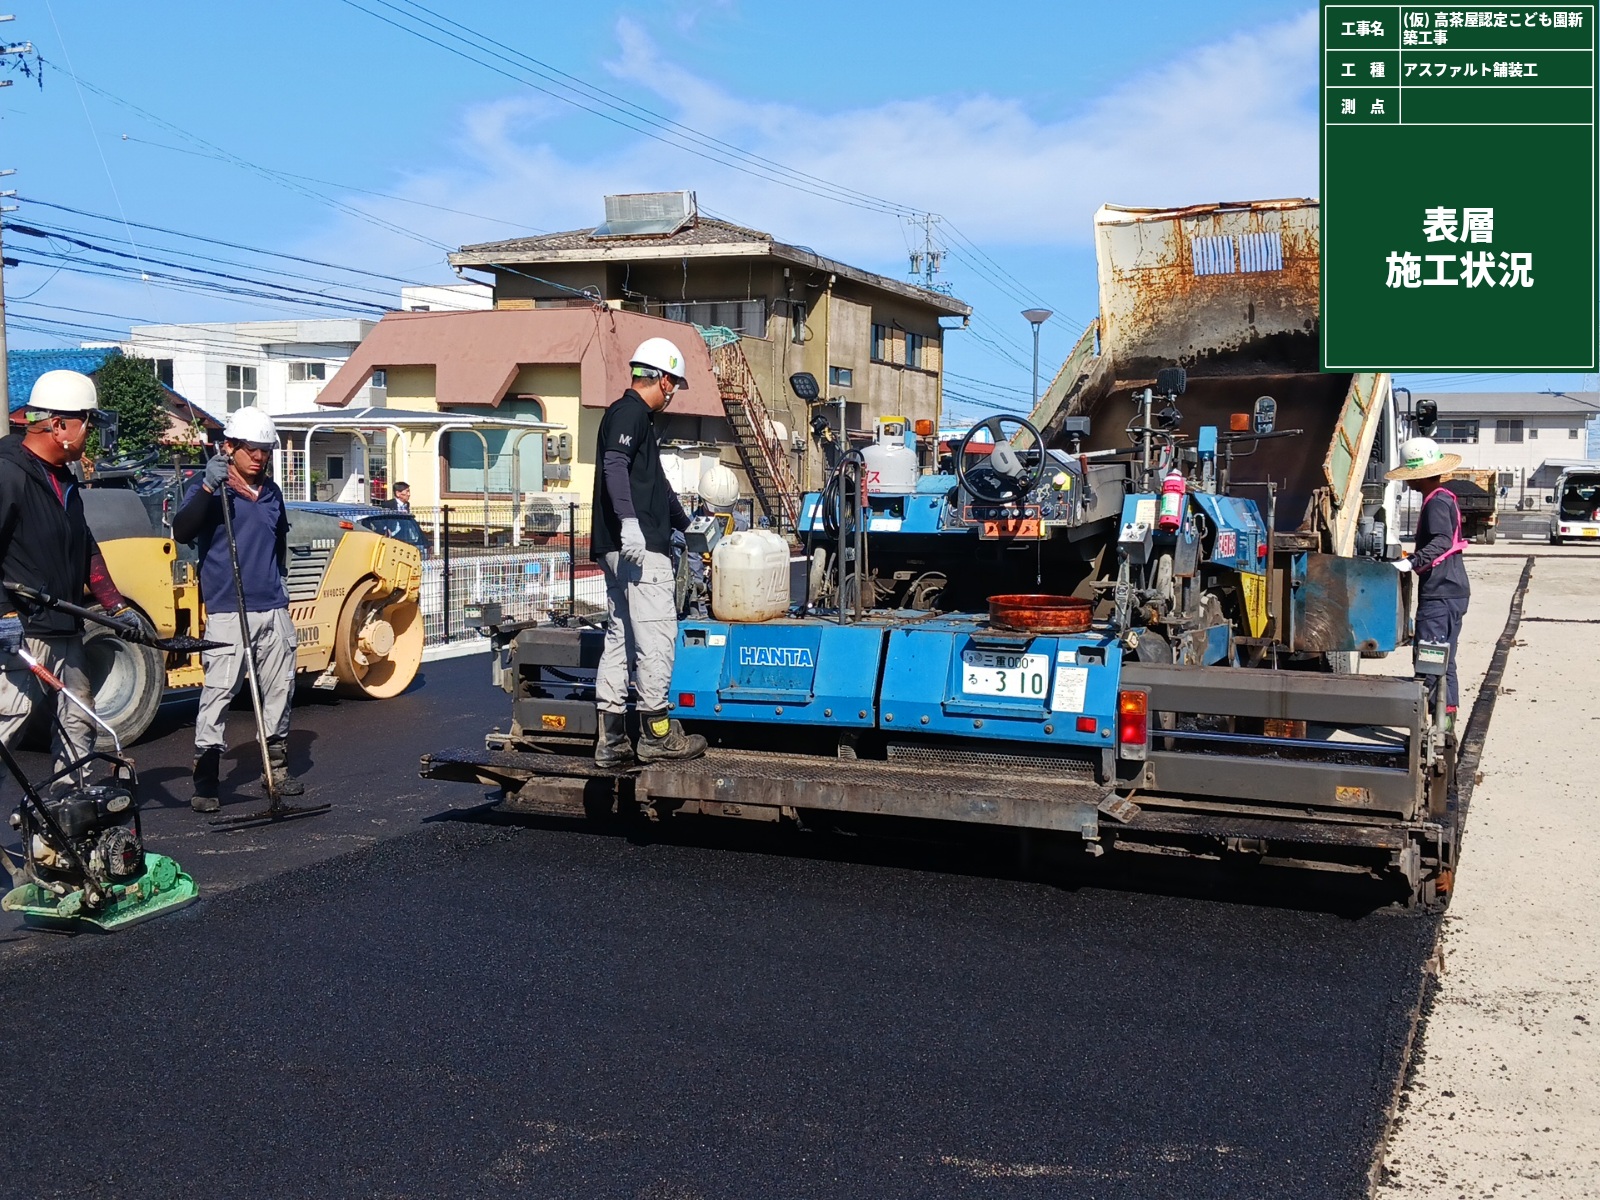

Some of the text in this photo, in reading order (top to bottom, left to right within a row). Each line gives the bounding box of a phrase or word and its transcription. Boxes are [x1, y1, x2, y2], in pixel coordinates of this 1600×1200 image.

[619, 434, 632, 446] MK
[297, 626, 319, 642] ANTO
[740, 646, 813, 667] HANTA
